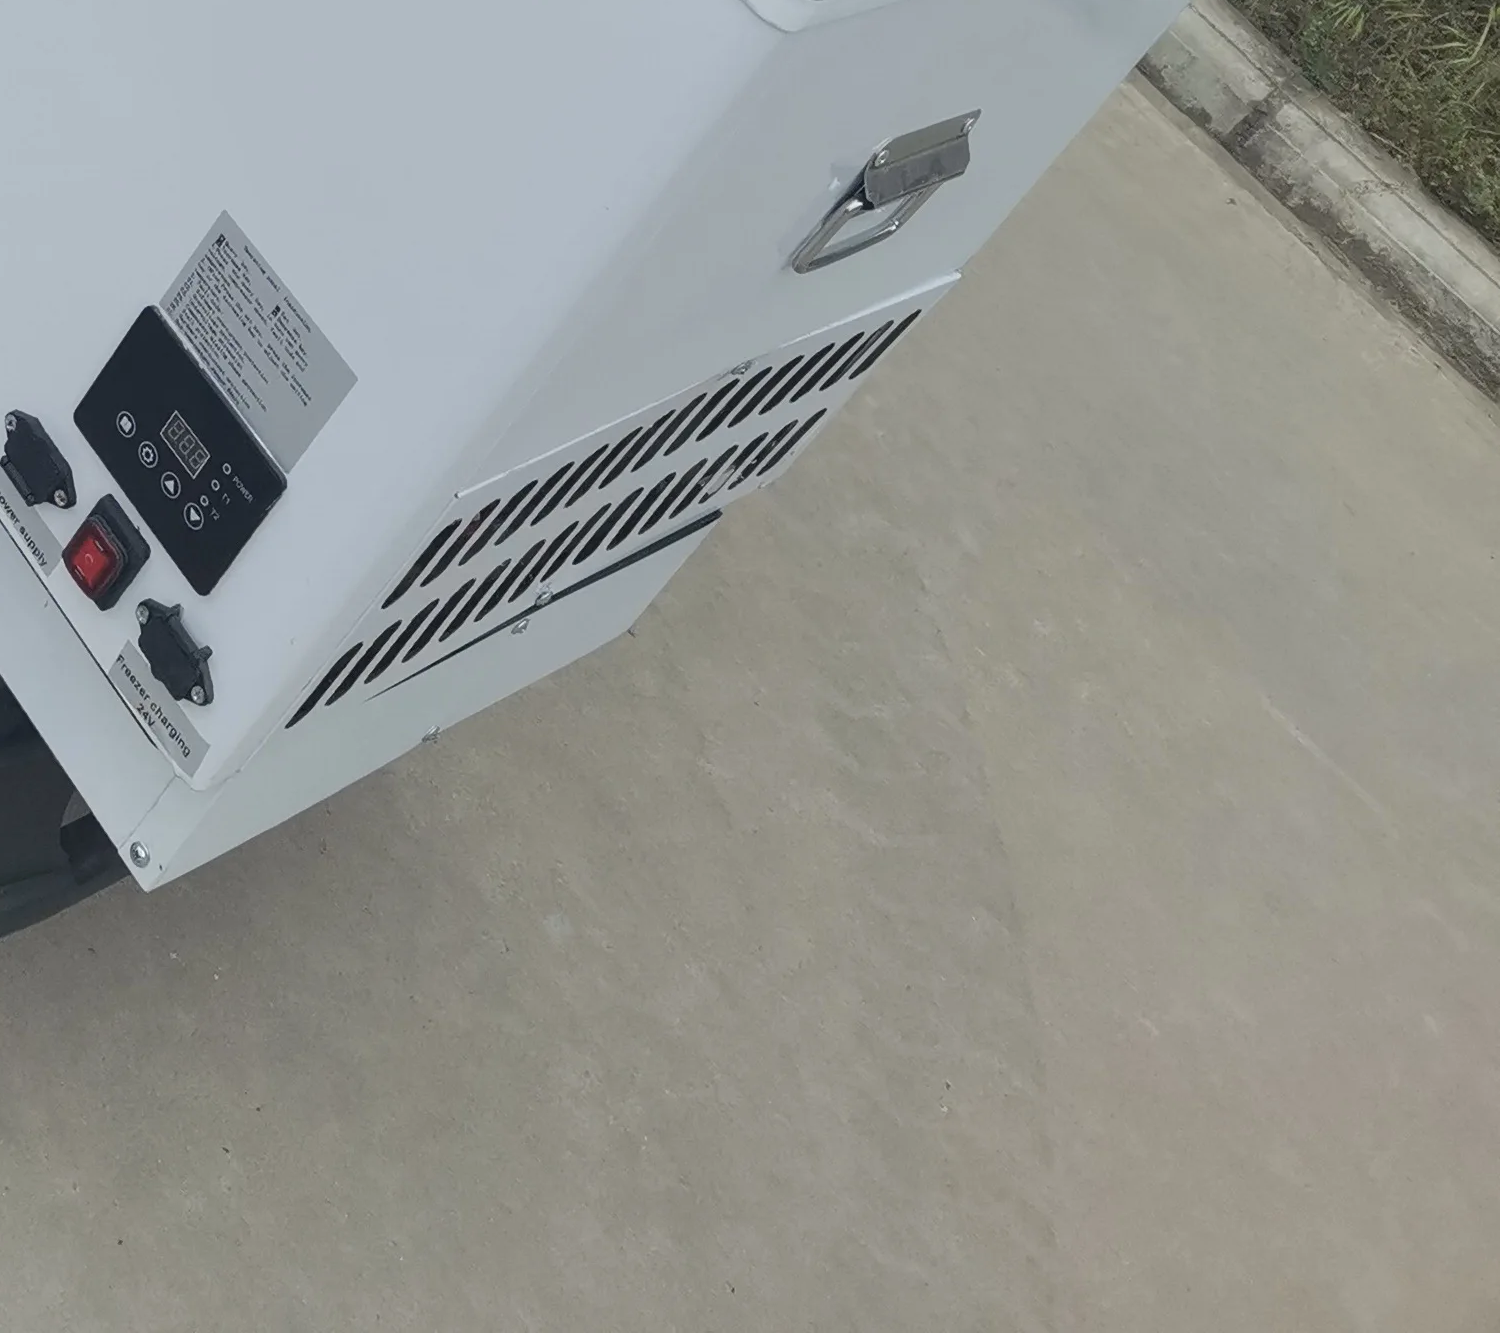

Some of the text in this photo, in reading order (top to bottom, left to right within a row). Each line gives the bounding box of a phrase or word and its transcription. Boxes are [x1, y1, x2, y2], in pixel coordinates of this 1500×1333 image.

[232, 476, 254, 504] POWER
[19, 526, 47, 566] supply
[116, 653, 191, 758] Freezer charging
[136, 703, 156, 727] 24V
